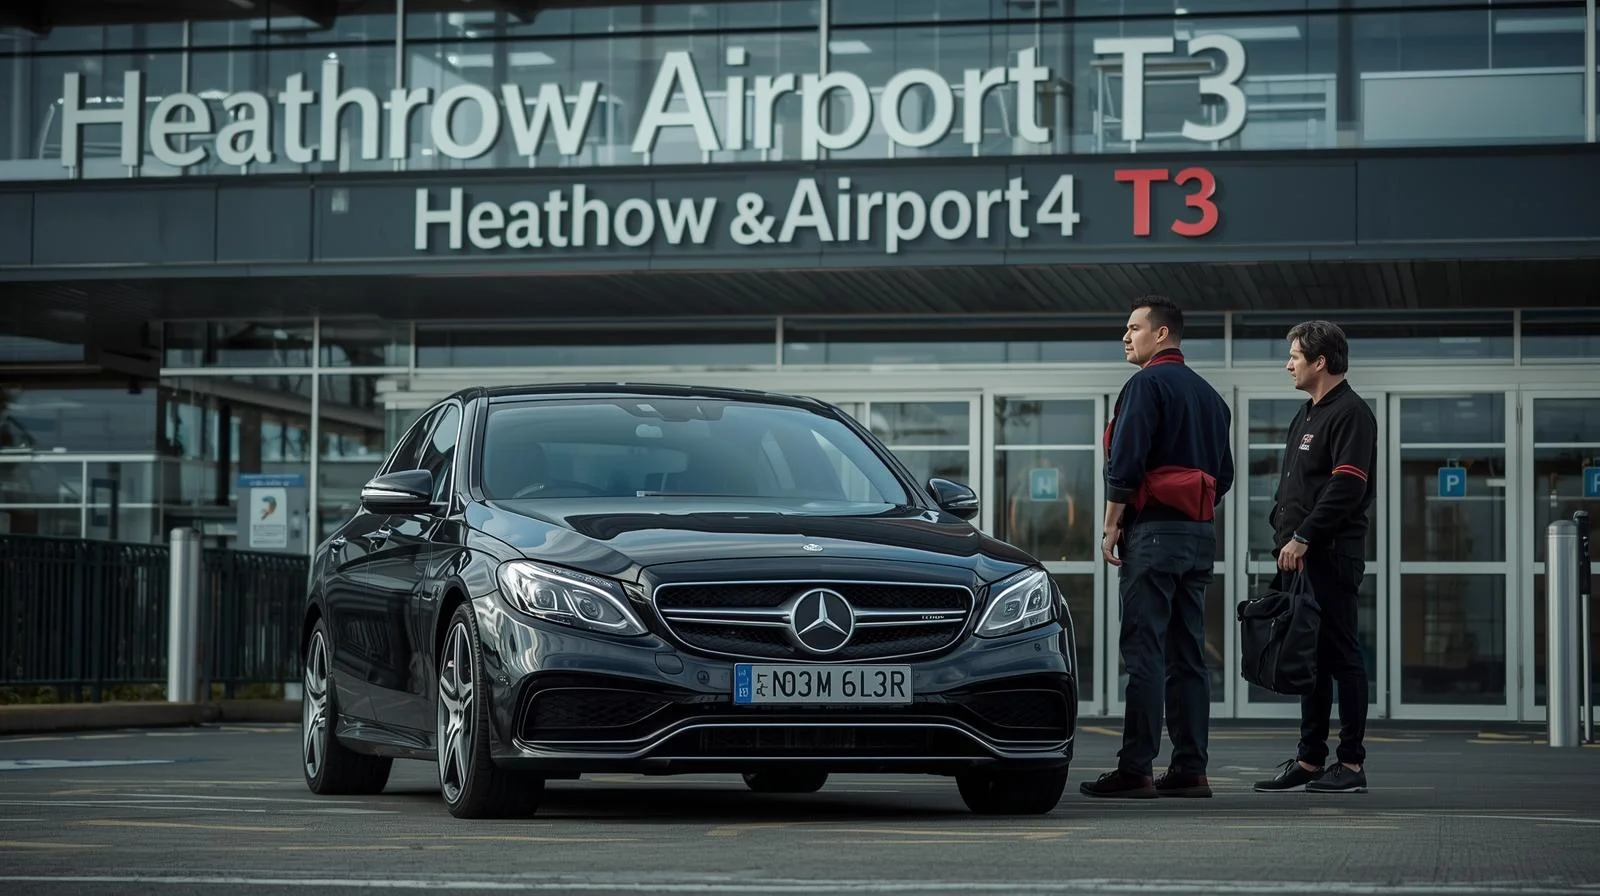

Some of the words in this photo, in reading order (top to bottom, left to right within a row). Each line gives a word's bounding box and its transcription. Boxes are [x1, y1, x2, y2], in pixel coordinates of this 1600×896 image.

[60, 60, 600, 167] Heathrow
[631, 46, 1051, 160] Airport
[1093, 34, 1248, 142] T3
[414, 184, 717, 250] Heathow
[1114, 167, 1220, 237] T3
[1446, 475, 1460, 492] P
